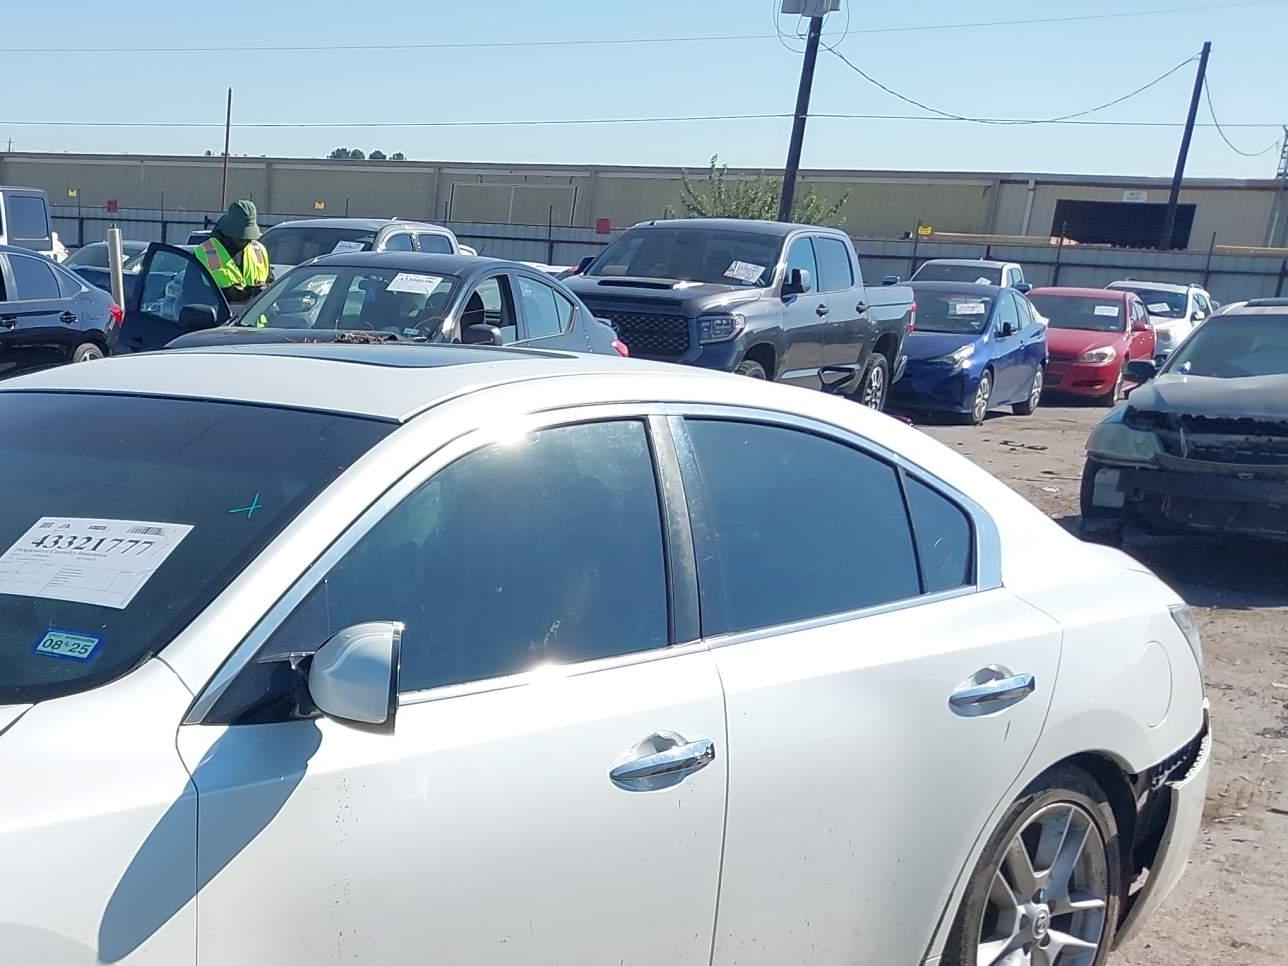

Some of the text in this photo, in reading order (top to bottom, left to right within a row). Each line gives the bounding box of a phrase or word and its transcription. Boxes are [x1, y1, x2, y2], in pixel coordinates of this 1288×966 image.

[31, 533, 158, 556] 43321777
[42, 638, 64, 650] 08
[67, 642, 92, 655] 25
